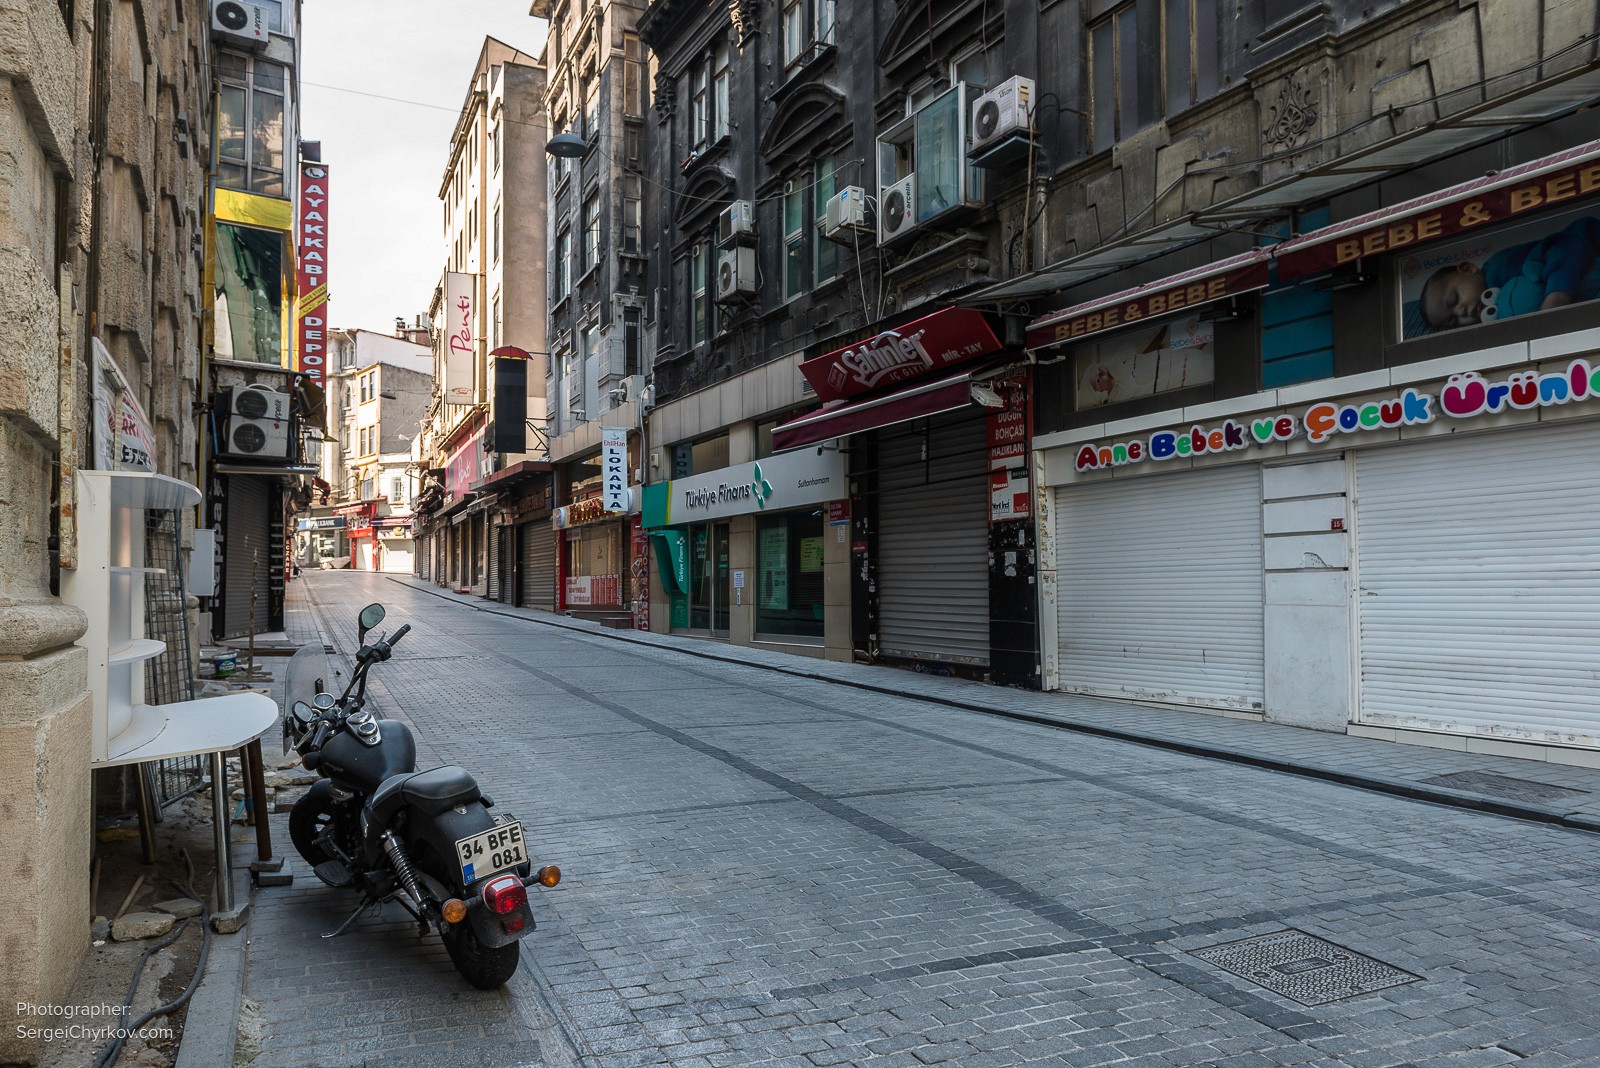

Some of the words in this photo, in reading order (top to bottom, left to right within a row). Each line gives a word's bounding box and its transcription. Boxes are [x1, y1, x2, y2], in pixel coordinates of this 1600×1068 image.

[304, 184, 324, 287] AYAKKABI
[1336, 213, 1442, 264] BEBE
[1459, 201, 1492, 228] &
[450, 295, 473, 356] Penti
[1055, 308, 1119, 341] BEBE
[1123, 303, 1143, 321] &
[1148, 276, 1227, 315] BEBE
[941, 349, 961, 362] MİR
[964, 341, 983, 354] TAY
[1075, 439, 1144, 472] Anne
[1149, 418, 1248, 461] Bebek
[1251, 414, 1298, 444] ve
[1303, 388, 1433, 443] Çocuk
[609, 448, 622, 508] LOKANTA
[685, 487, 717, 510] Türkiye
[718, 483, 751, 503] Finans
[797, 477, 830, 490] Sultanhamam
[461, 840, 483, 860] 34
[487, 826, 521, 850] BFE
[491, 845, 522, 869] 081
